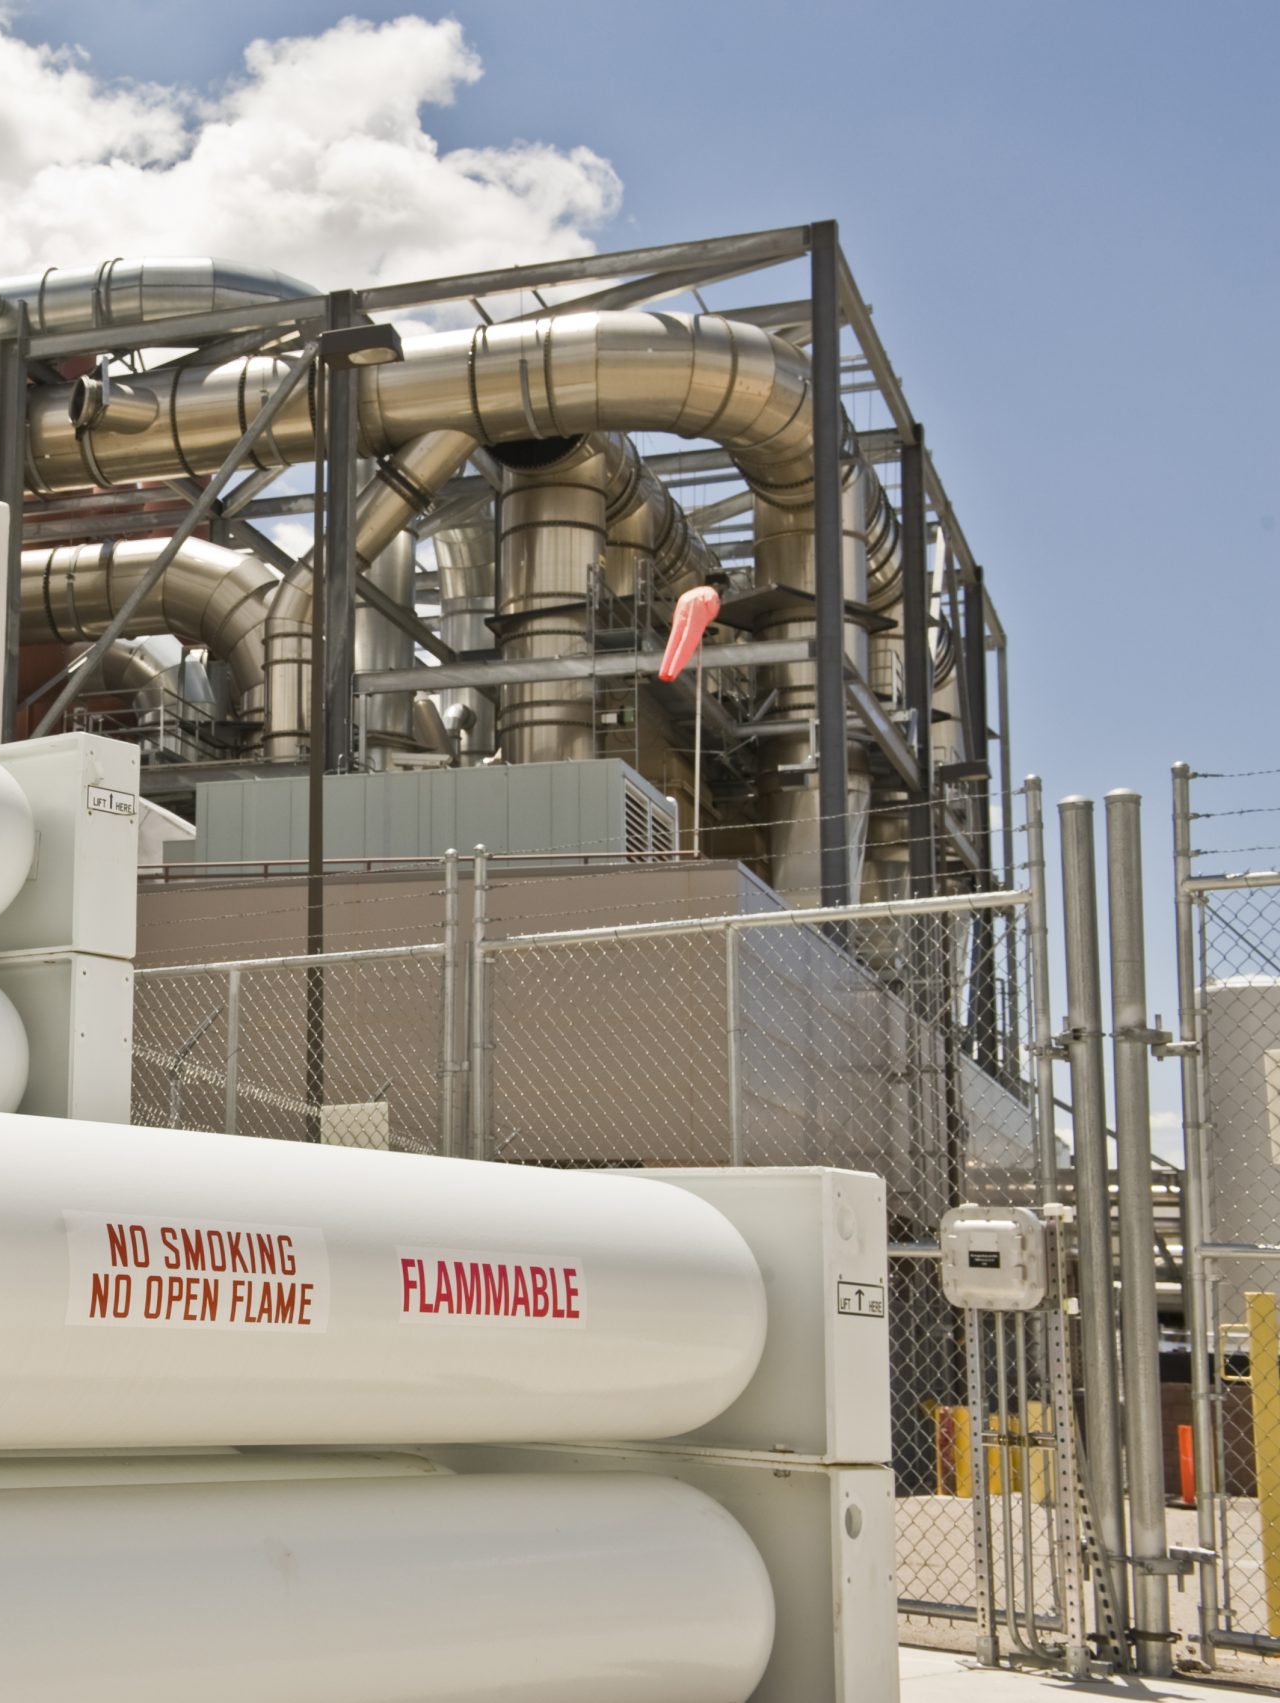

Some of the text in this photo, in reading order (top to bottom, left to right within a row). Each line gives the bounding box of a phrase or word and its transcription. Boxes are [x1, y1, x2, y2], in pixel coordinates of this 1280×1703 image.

[93, 797, 132, 814] LIFT HERE
[107, 1224, 297, 1276] NO SMOKING
[89, 1273, 315, 1325] NO OPEN FLAME
[401, 1257, 581, 1319] FLAMMABLE
